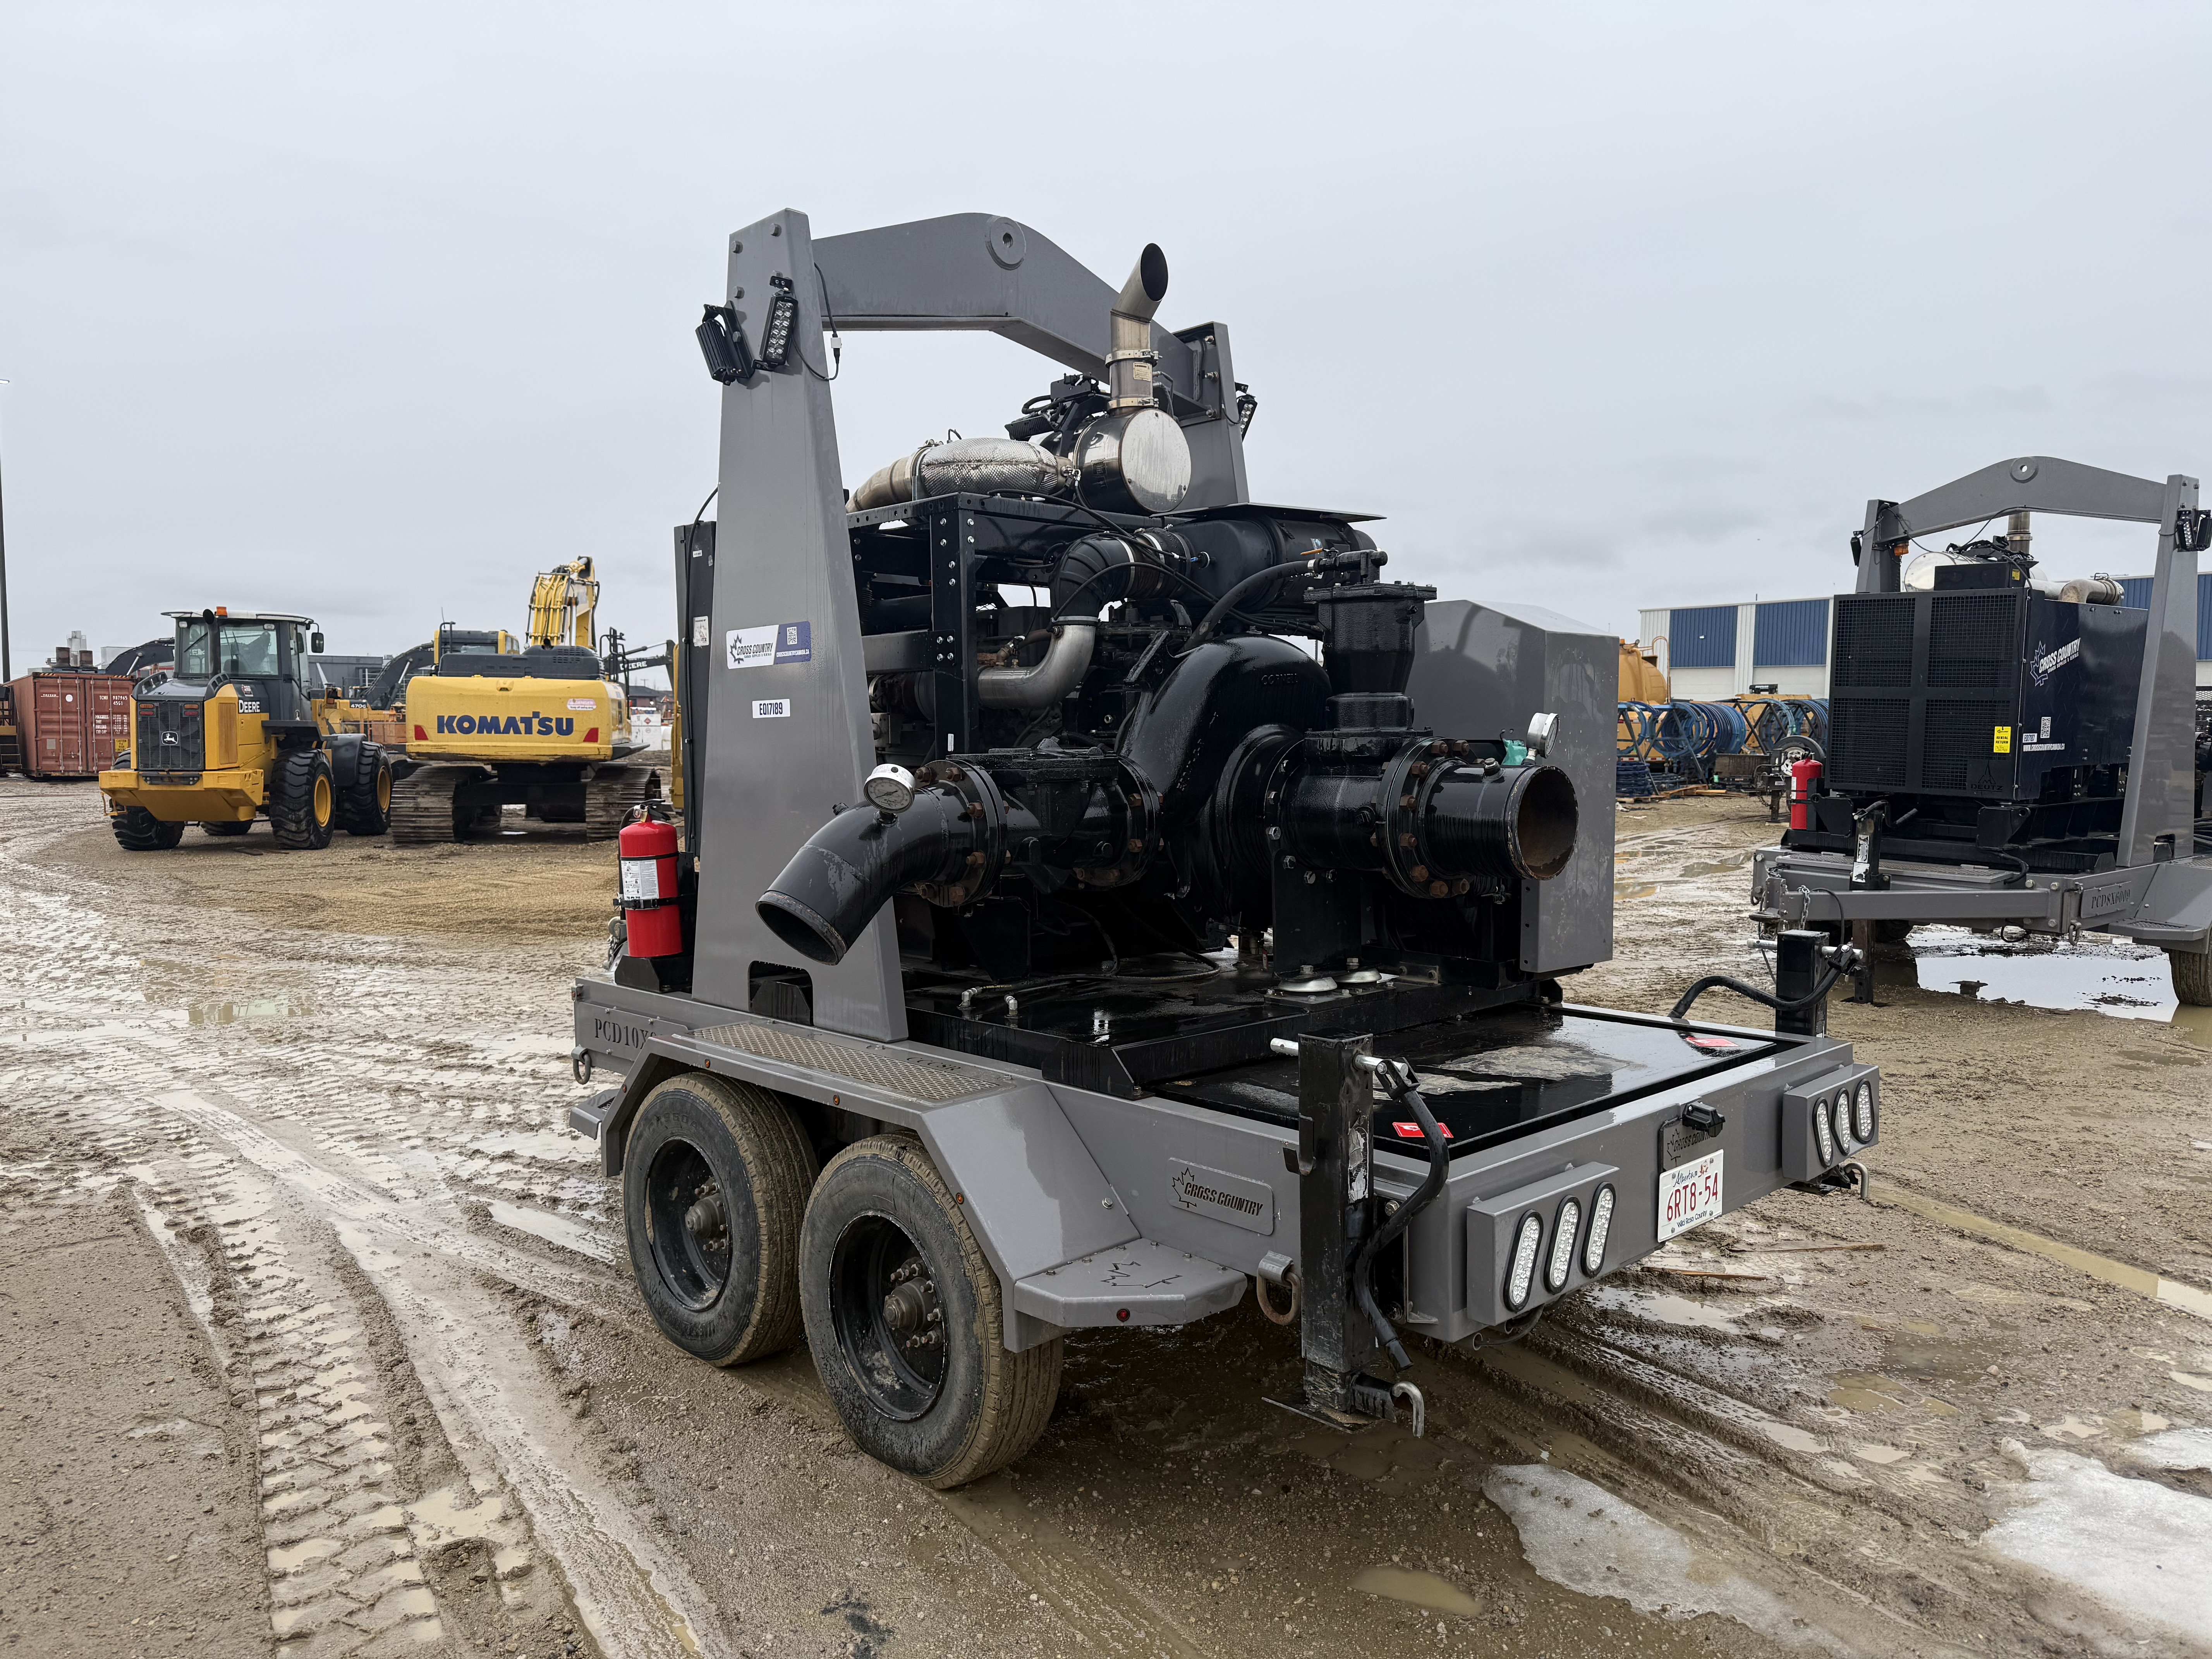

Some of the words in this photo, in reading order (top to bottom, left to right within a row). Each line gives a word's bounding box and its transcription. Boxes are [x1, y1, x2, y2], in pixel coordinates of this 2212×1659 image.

[737, 646, 752, 656] CROSS
[752, 642, 773, 654] COUNTRY
[2039, 651, 2057, 673] CROSS
[2057, 637, 2081, 663] COUNTRY
[239, 699, 260, 713] DEERE
[759, 702, 783, 715] EQ17189
[437, 711, 574, 736] KOMATSU
[1674, 1135, 1692, 1152] CROSS
[1184, 1182, 1217, 1203] CROSS
[1217, 1192, 1263, 1216] COUNTRY
[1667, 1172, 1718, 1221] 6RT8-54
[1676, 1219, 1685, 1228] Wild
[1685, 1216, 1694, 1224] Rose
[1695, 1210, 1707, 1220] Country
